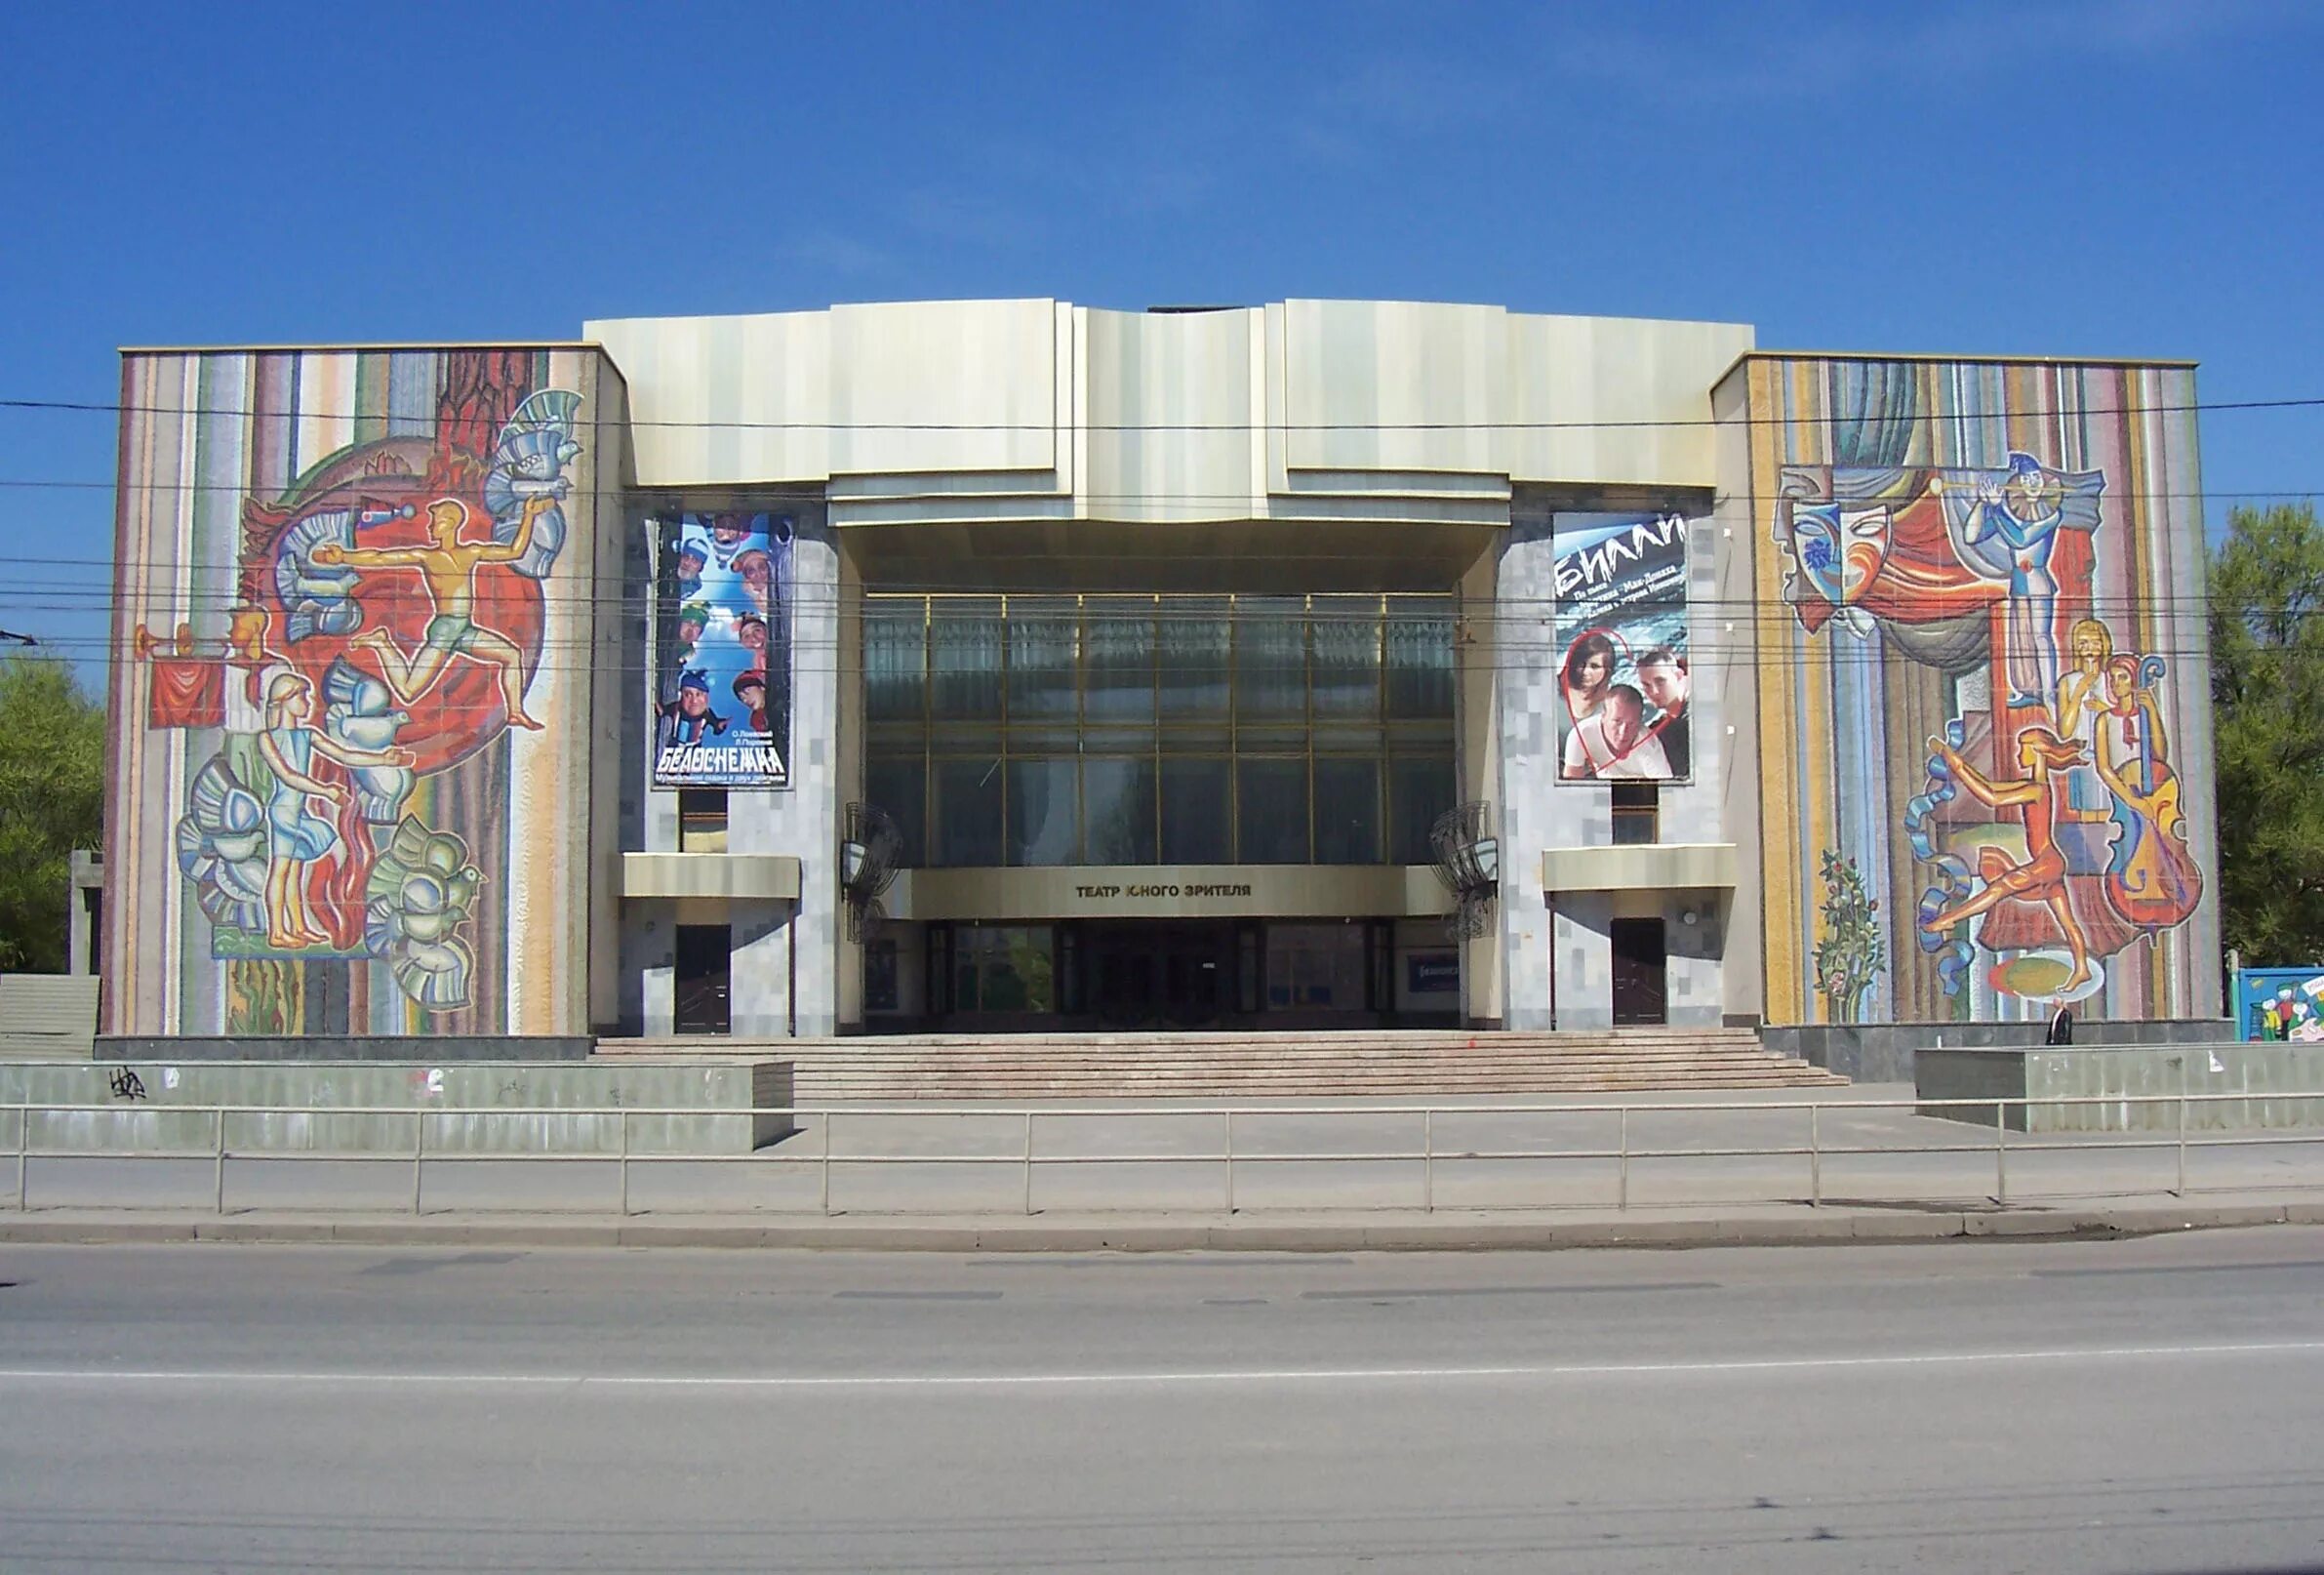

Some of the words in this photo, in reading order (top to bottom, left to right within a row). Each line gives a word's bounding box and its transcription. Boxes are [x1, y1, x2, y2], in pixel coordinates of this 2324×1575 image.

[656, 747, 785, 773] БЕЛОСНЕЖКА
[1076, 886, 1120, 898] ТЕАТР
[1184, 884, 1251, 897] ЗРИТЕЛЯ
